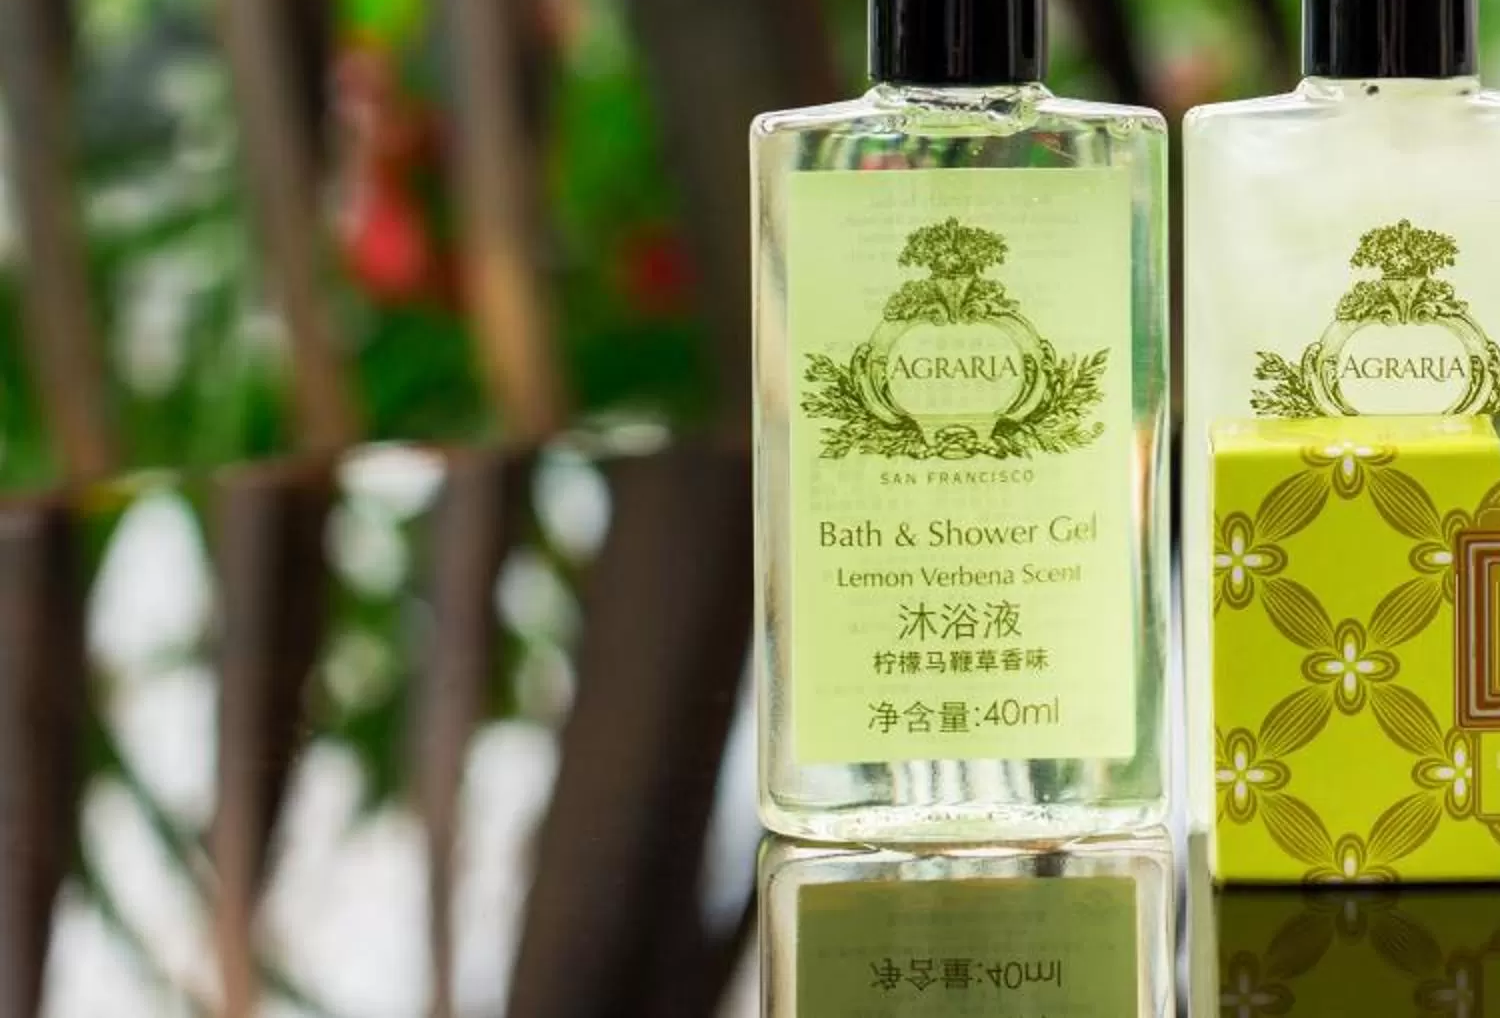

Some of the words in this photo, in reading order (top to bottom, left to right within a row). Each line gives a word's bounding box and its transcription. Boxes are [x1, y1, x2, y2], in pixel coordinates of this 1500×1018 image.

[891, 354, 1019, 382] AGRARIA
[1340, 354, 1465, 382] AGRARIA
[880, 471, 917, 486] SAN
[927, 469, 1035, 485] FRANCISCO
[819, 520, 882, 548] Bath
[894, 522, 917, 548] &
[928, 517, 1039, 547] Shower
[1048, 512, 1098, 543] Gel
[837, 567, 914, 588] Lemon
[921, 565, 1015, 587] Verbena
[1022, 562, 1081, 584] Scent
[898, 600, 1023, 642] 沐浴液
[873, 647, 1051, 675] 柠檬马鞭草香味
